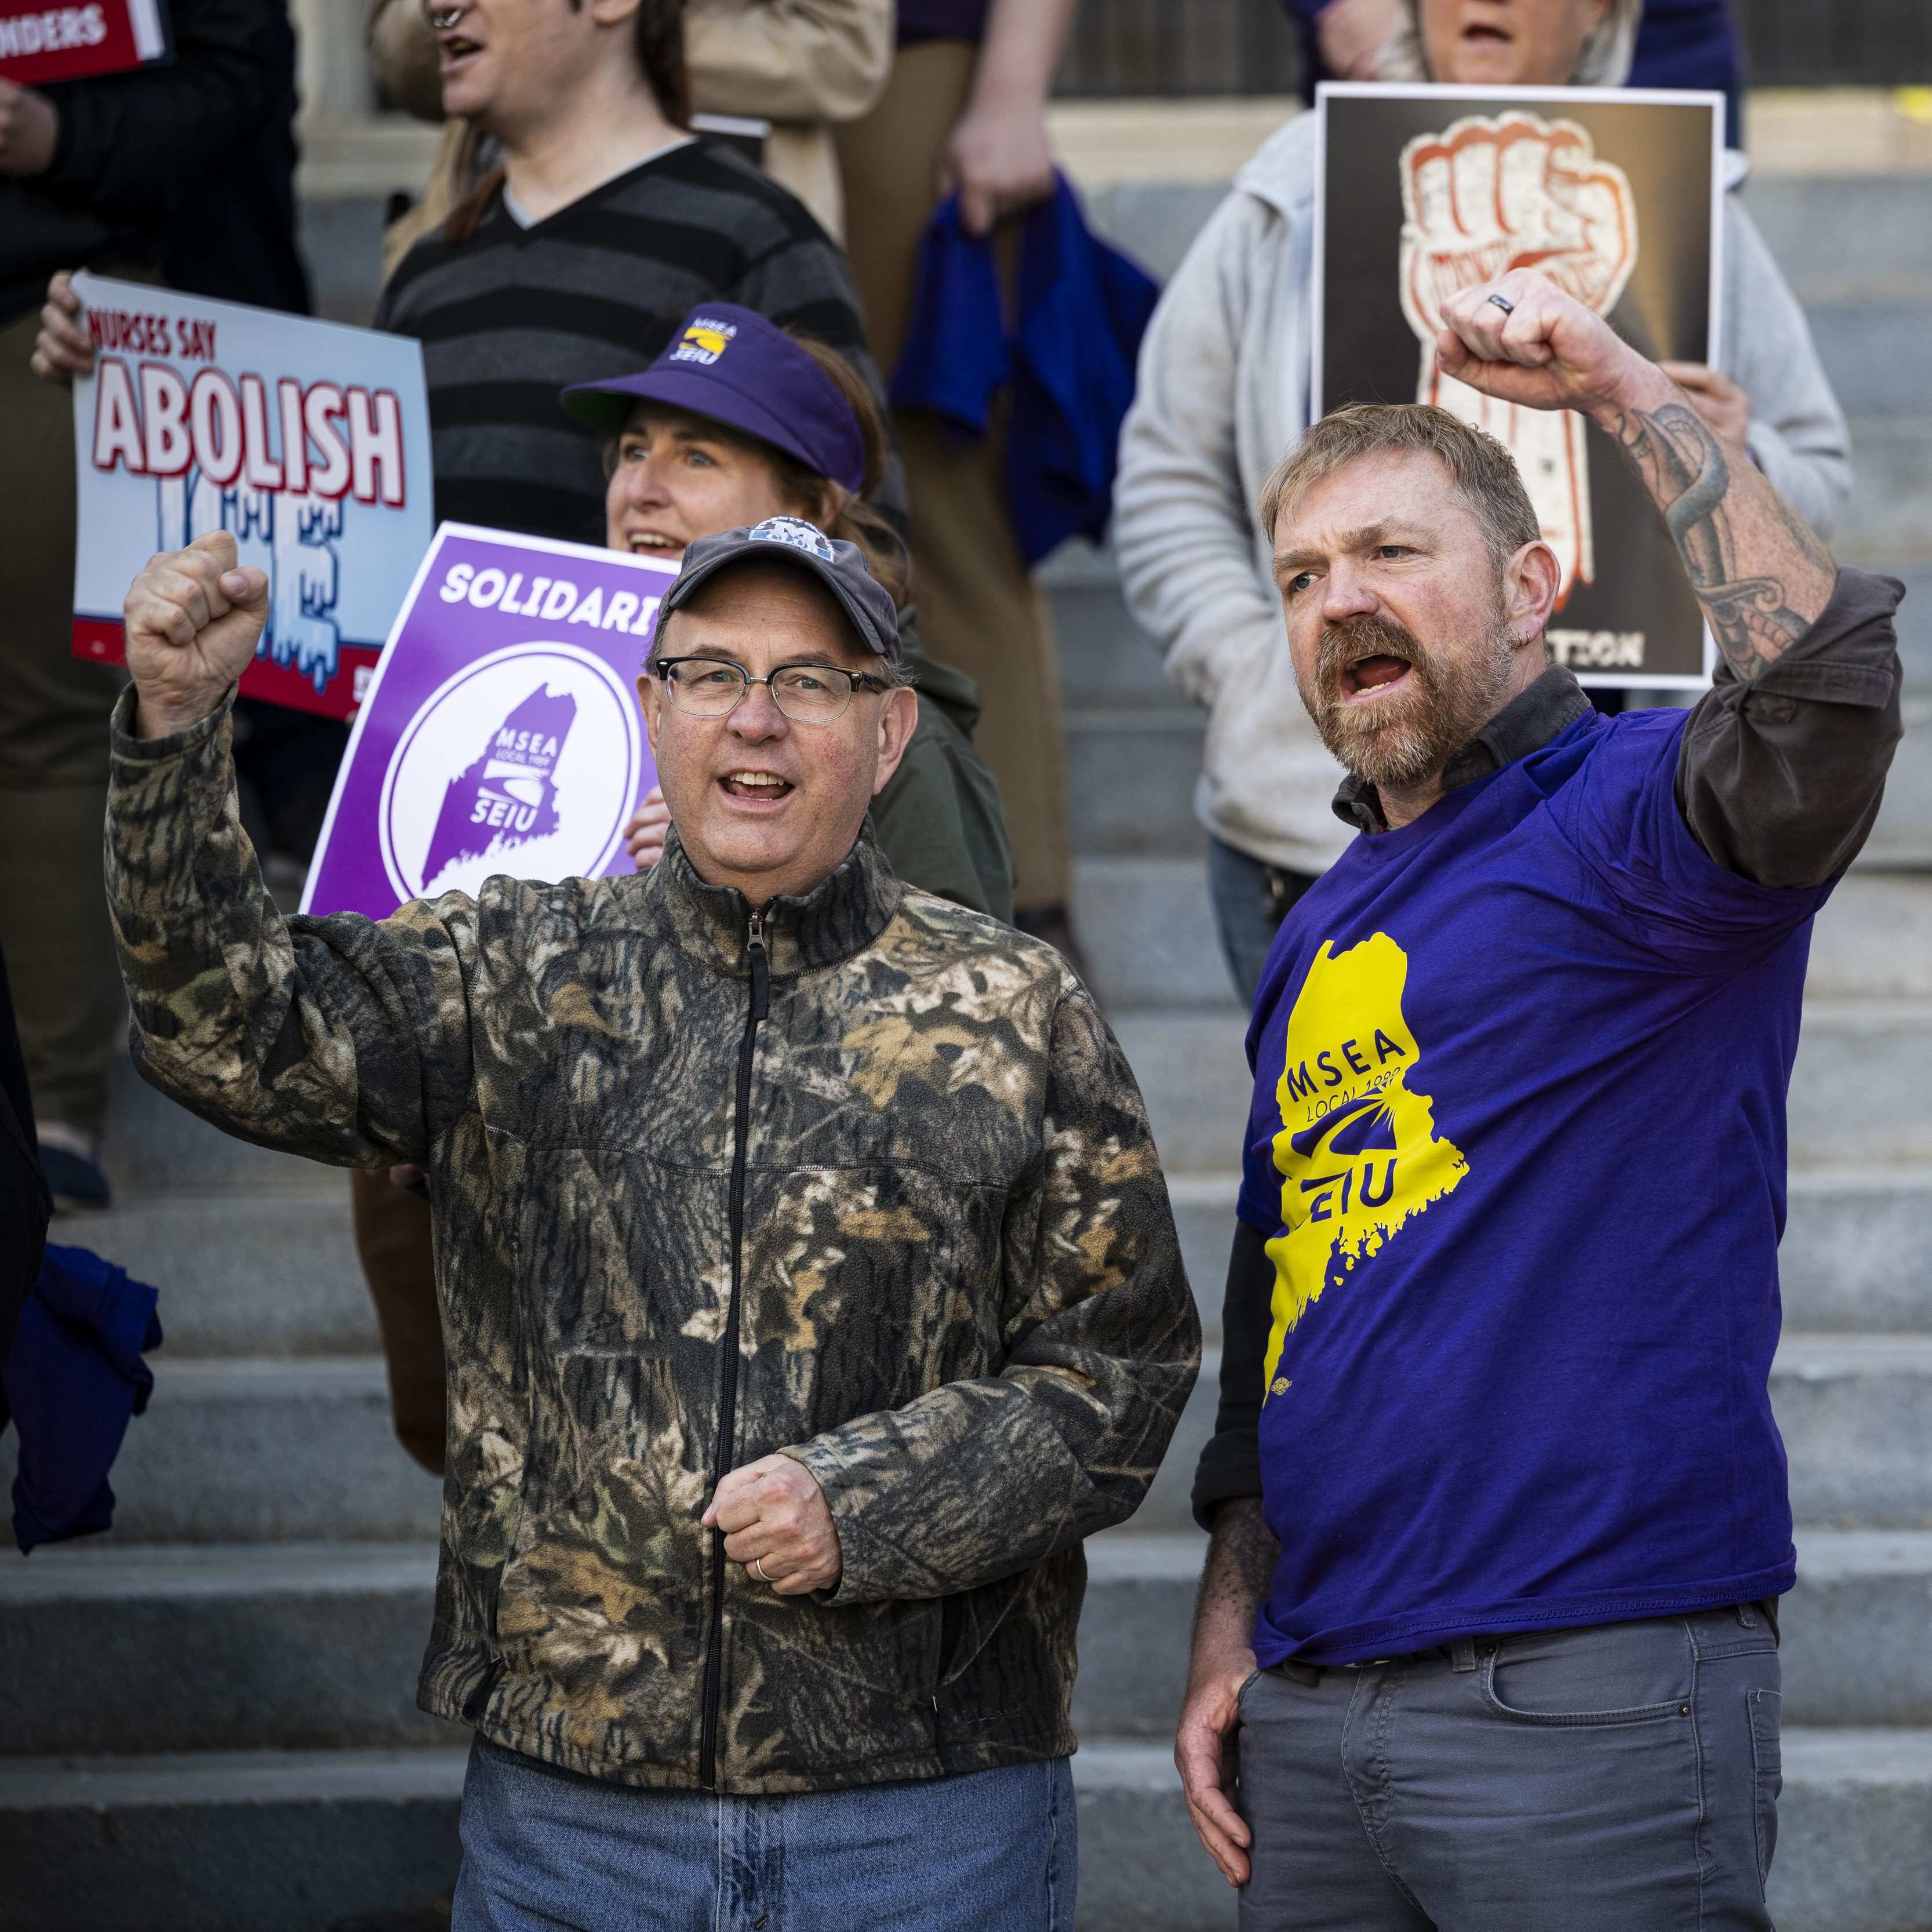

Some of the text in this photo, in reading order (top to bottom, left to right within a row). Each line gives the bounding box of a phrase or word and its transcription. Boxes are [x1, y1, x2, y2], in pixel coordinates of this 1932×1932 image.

[86, 308, 216, 363] NURSES SAY
[669, 348, 721, 365] SEIU
[92, 358, 405, 510] ABOLISH
[439, 562, 662, 636] SOLIDARI
[495, 727, 558, 758] MSEA
[469, 798, 539, 832] SEIU
[1287, 1028, 1406, 1103] MSEA
[1307, 1086, 1355, 1122] LOCAL
[1309, 1158, 1398, 1224] EIU
